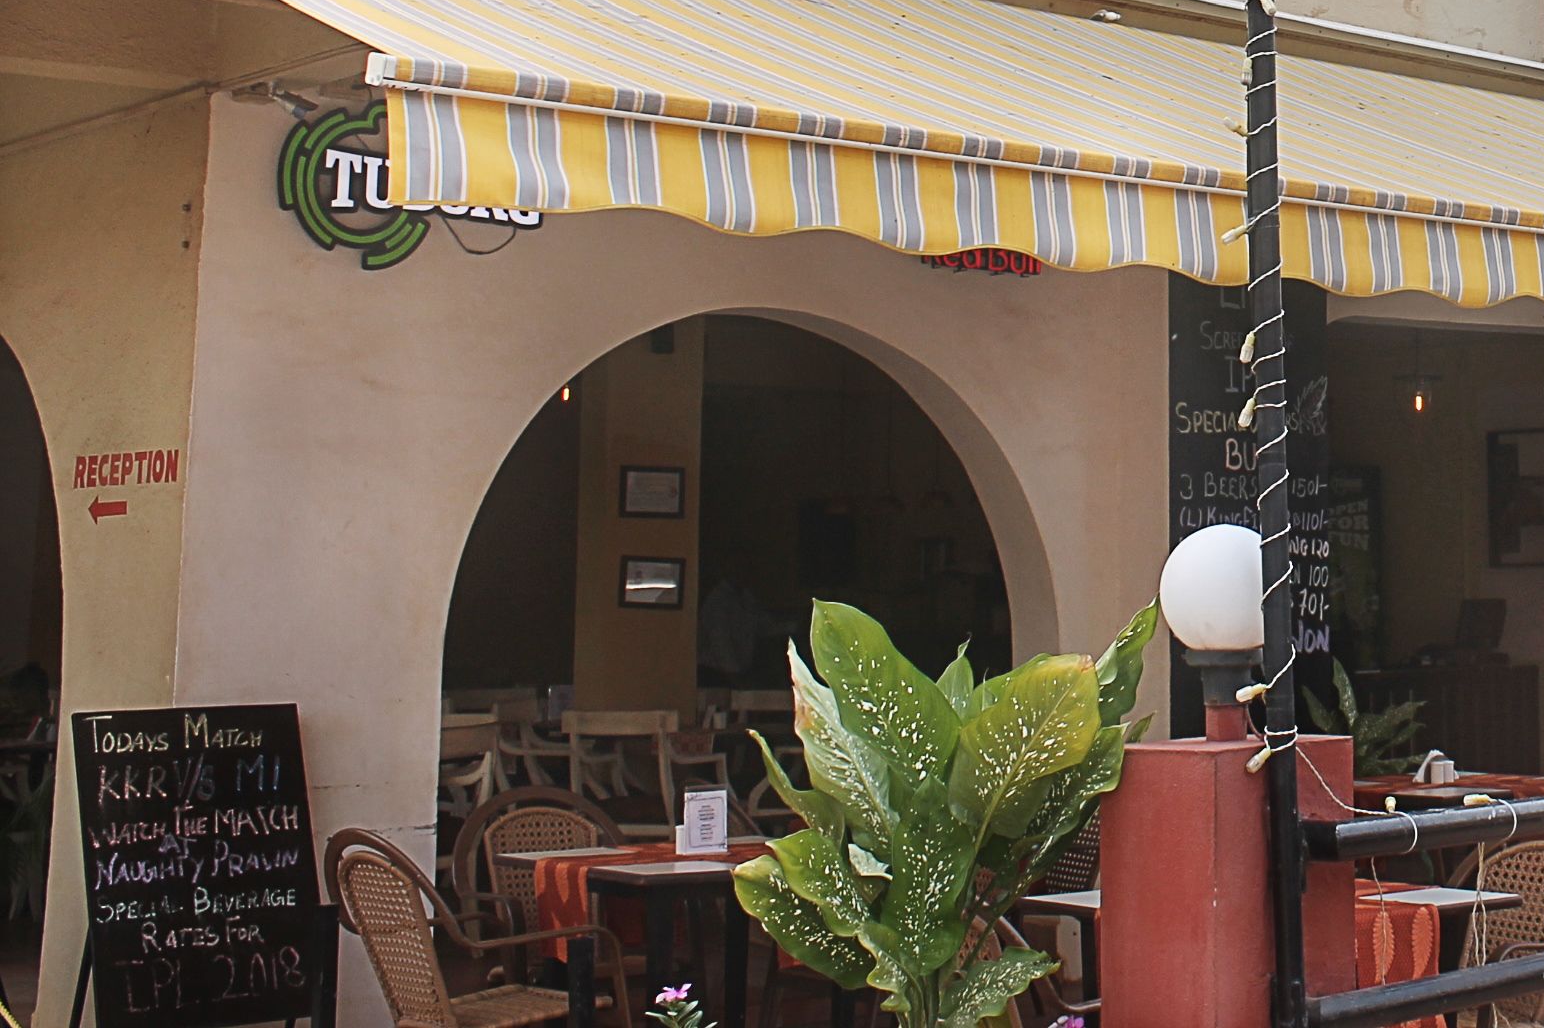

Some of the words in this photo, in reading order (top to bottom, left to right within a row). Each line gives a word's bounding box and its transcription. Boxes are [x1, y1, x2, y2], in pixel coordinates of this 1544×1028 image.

[73, 449, 179, 490] RECEPTION
[184, 713, 263, 749] MATCH
[98, 764, 168, 807] KKR
[193, 886, 297, 916] BEVERAGE
